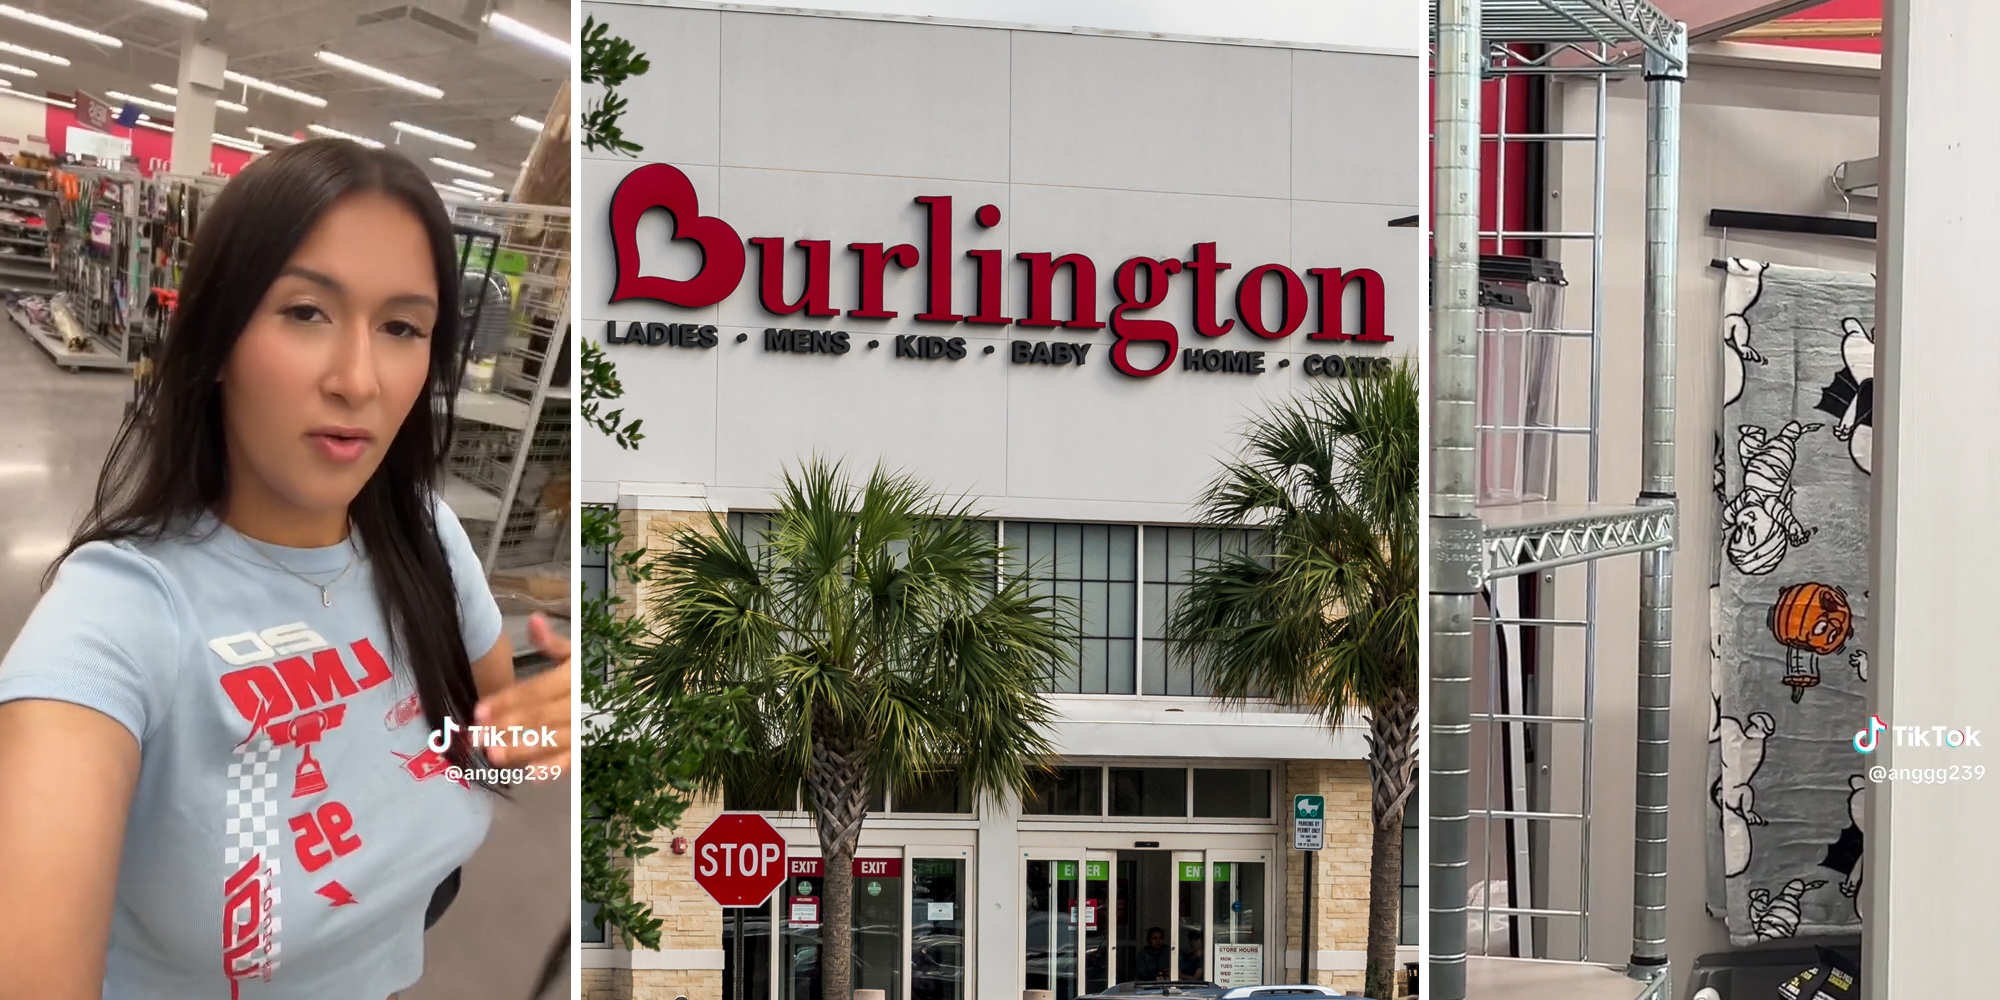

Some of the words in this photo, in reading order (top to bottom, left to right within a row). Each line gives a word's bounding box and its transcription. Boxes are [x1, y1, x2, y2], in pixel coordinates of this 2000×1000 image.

[609, 163, 1394, 378] Burlington
[606, 320, 718, 349] LADIES
[765, 327, 850, 355] MENS
[896, 334, 967, 360] KIDS
[1011, 340, 1091, 367] BABY
[1183, 347, 1265, 374] HOME
[699, 843, 780, 877] STOP
[791, 861, 818, 873] EXIT
[861, 861, 887, 874] EXIT
